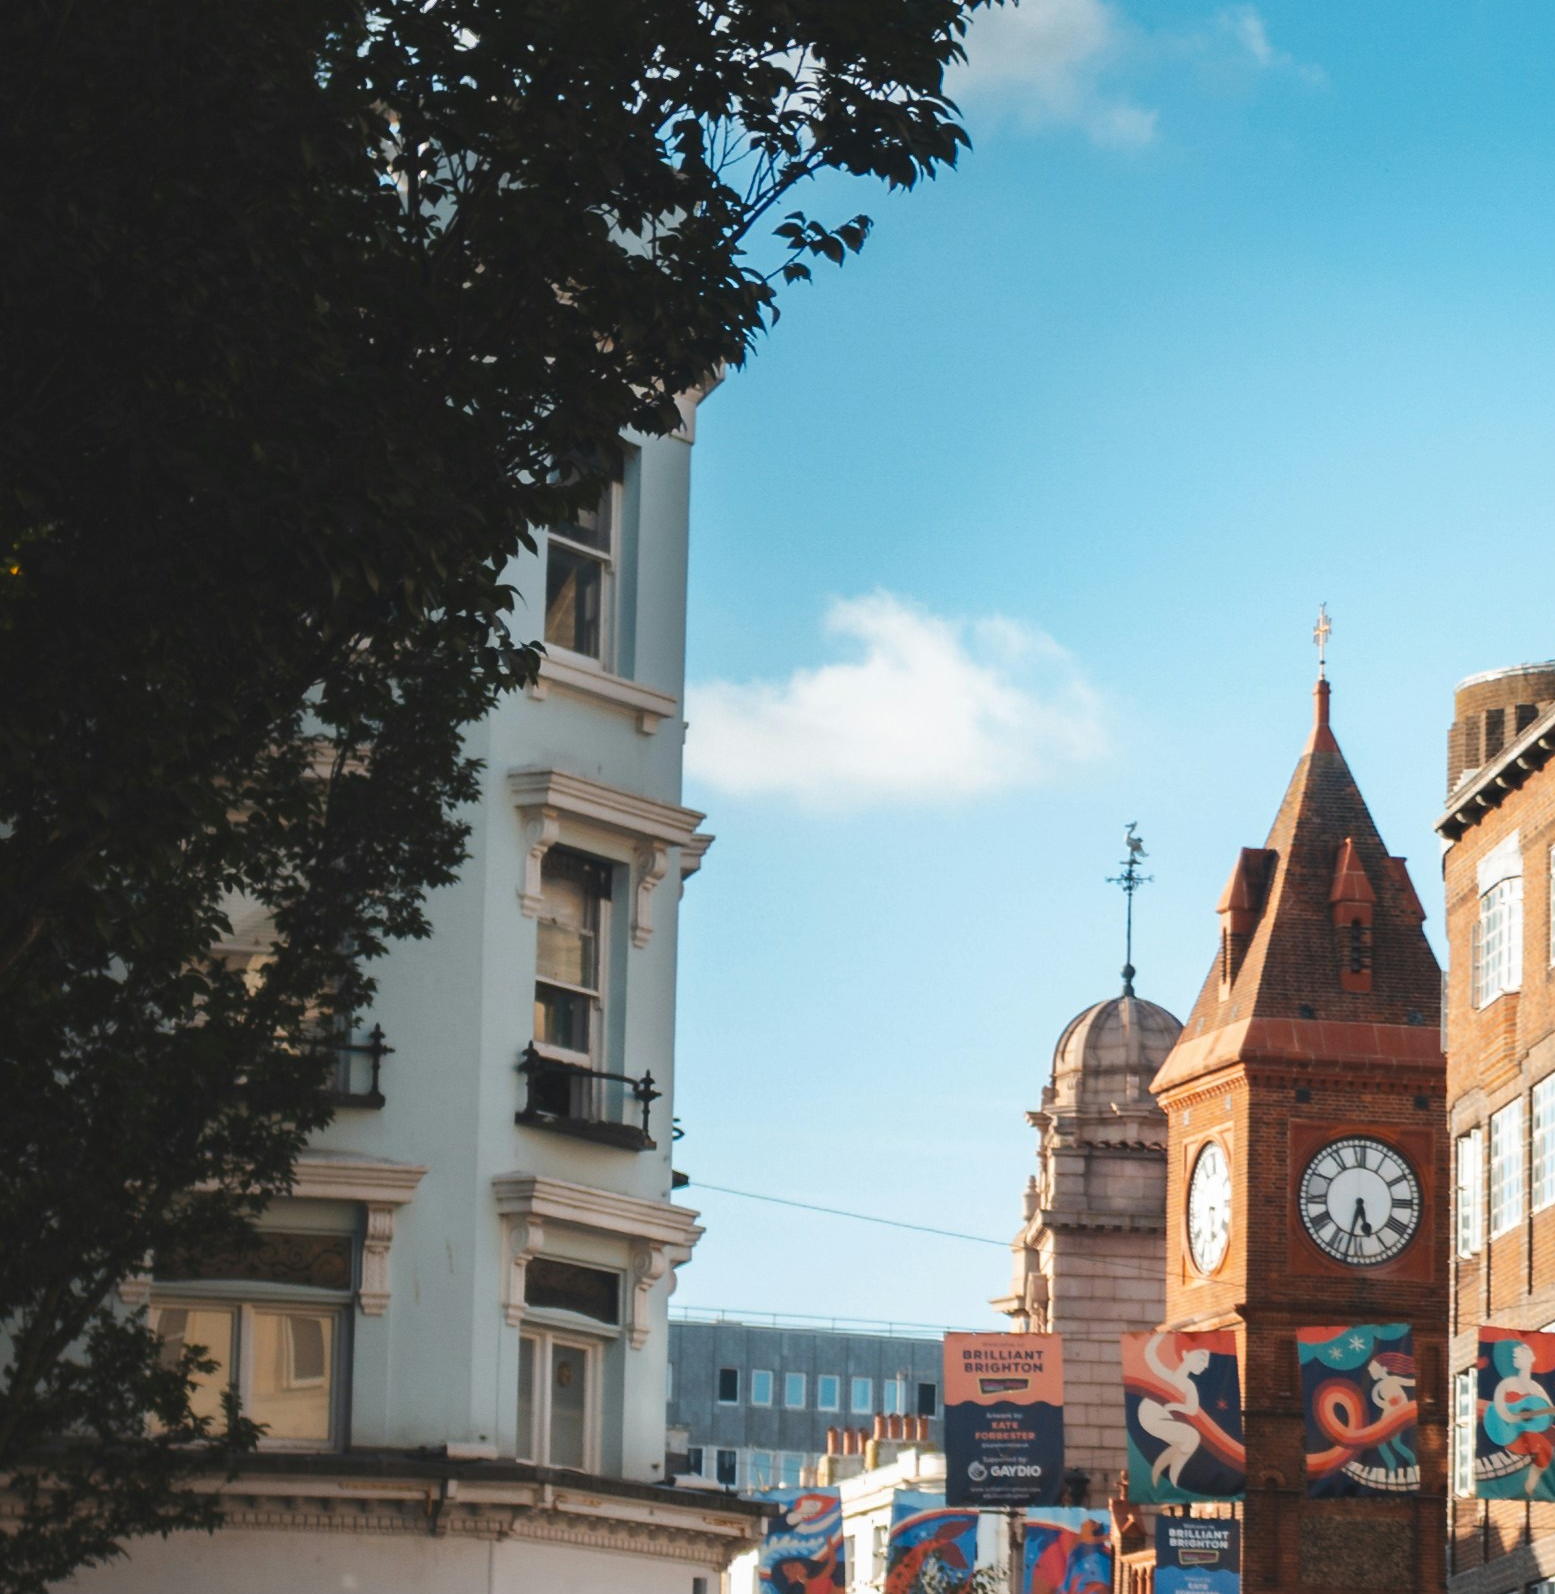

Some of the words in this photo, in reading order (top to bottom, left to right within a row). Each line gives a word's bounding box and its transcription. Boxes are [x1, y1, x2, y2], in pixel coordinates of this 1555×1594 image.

[962, 1350, 1044, 1360] BRILLIANT
[963, 1362, 1044, 1373] BRIGHTON
[974, 1431, 1036, 1440] FORRESTER
[990, 1465, 1042, 1477] GAYDIO
[1168, 1528, 1230, 1540] BRILLIANT
[1169, 1538, 1229, 1549] BRIGHTON
